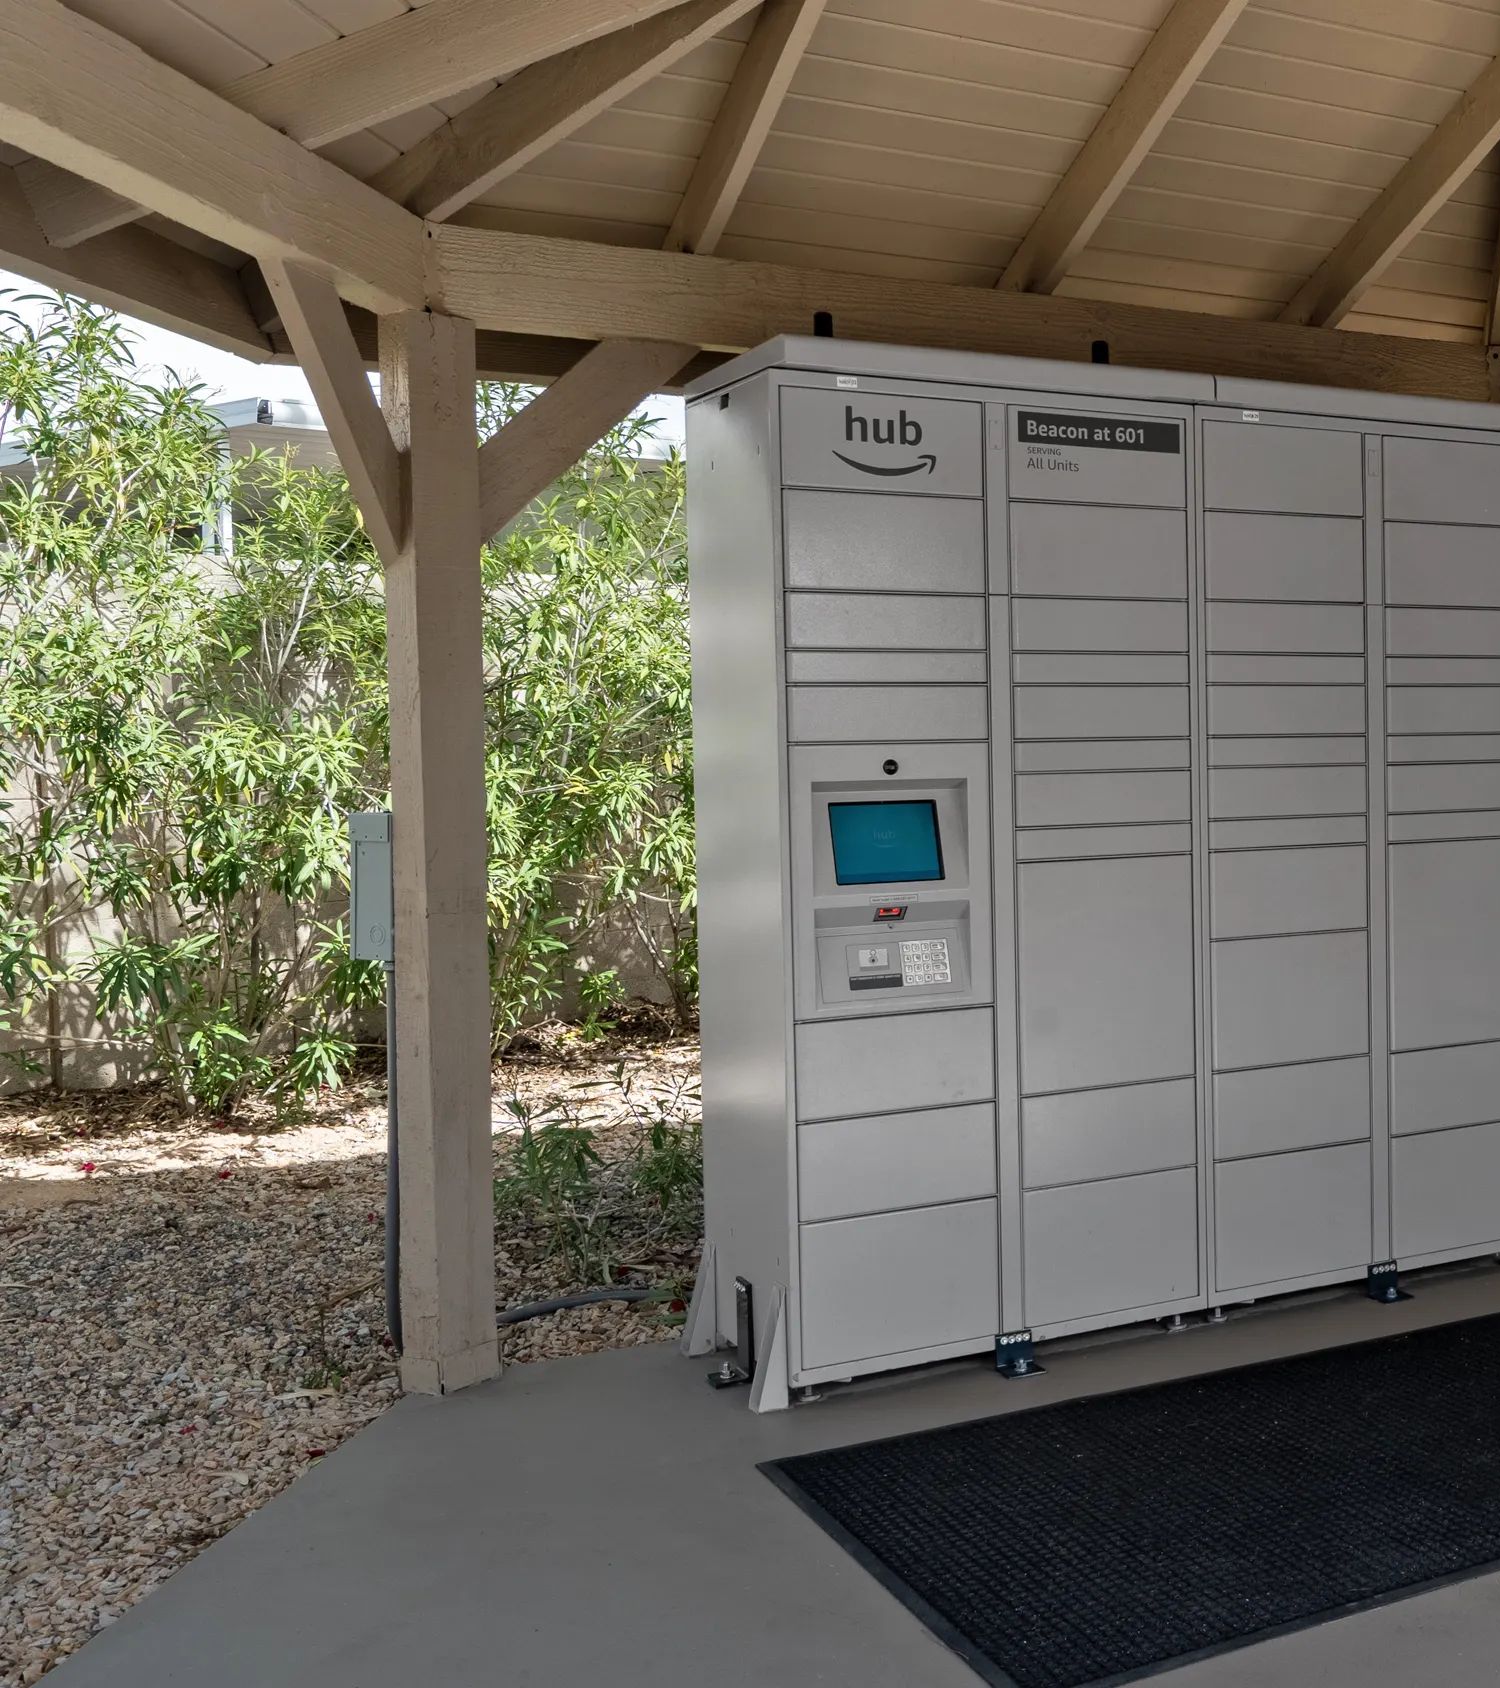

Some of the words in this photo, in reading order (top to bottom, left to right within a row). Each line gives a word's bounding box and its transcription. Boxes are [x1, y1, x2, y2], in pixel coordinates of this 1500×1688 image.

[845, 405, 923, 446] hub
[1026, 419, 1088, 440] Beacon
[1093, 426, 1111, 441] at
[1115, 427, 1145, 444] 601
[1027, 446, 1062, 456] SERVING
[1026, 457, 1044, 470] All
[1047, 458, 1080, 473] Units
